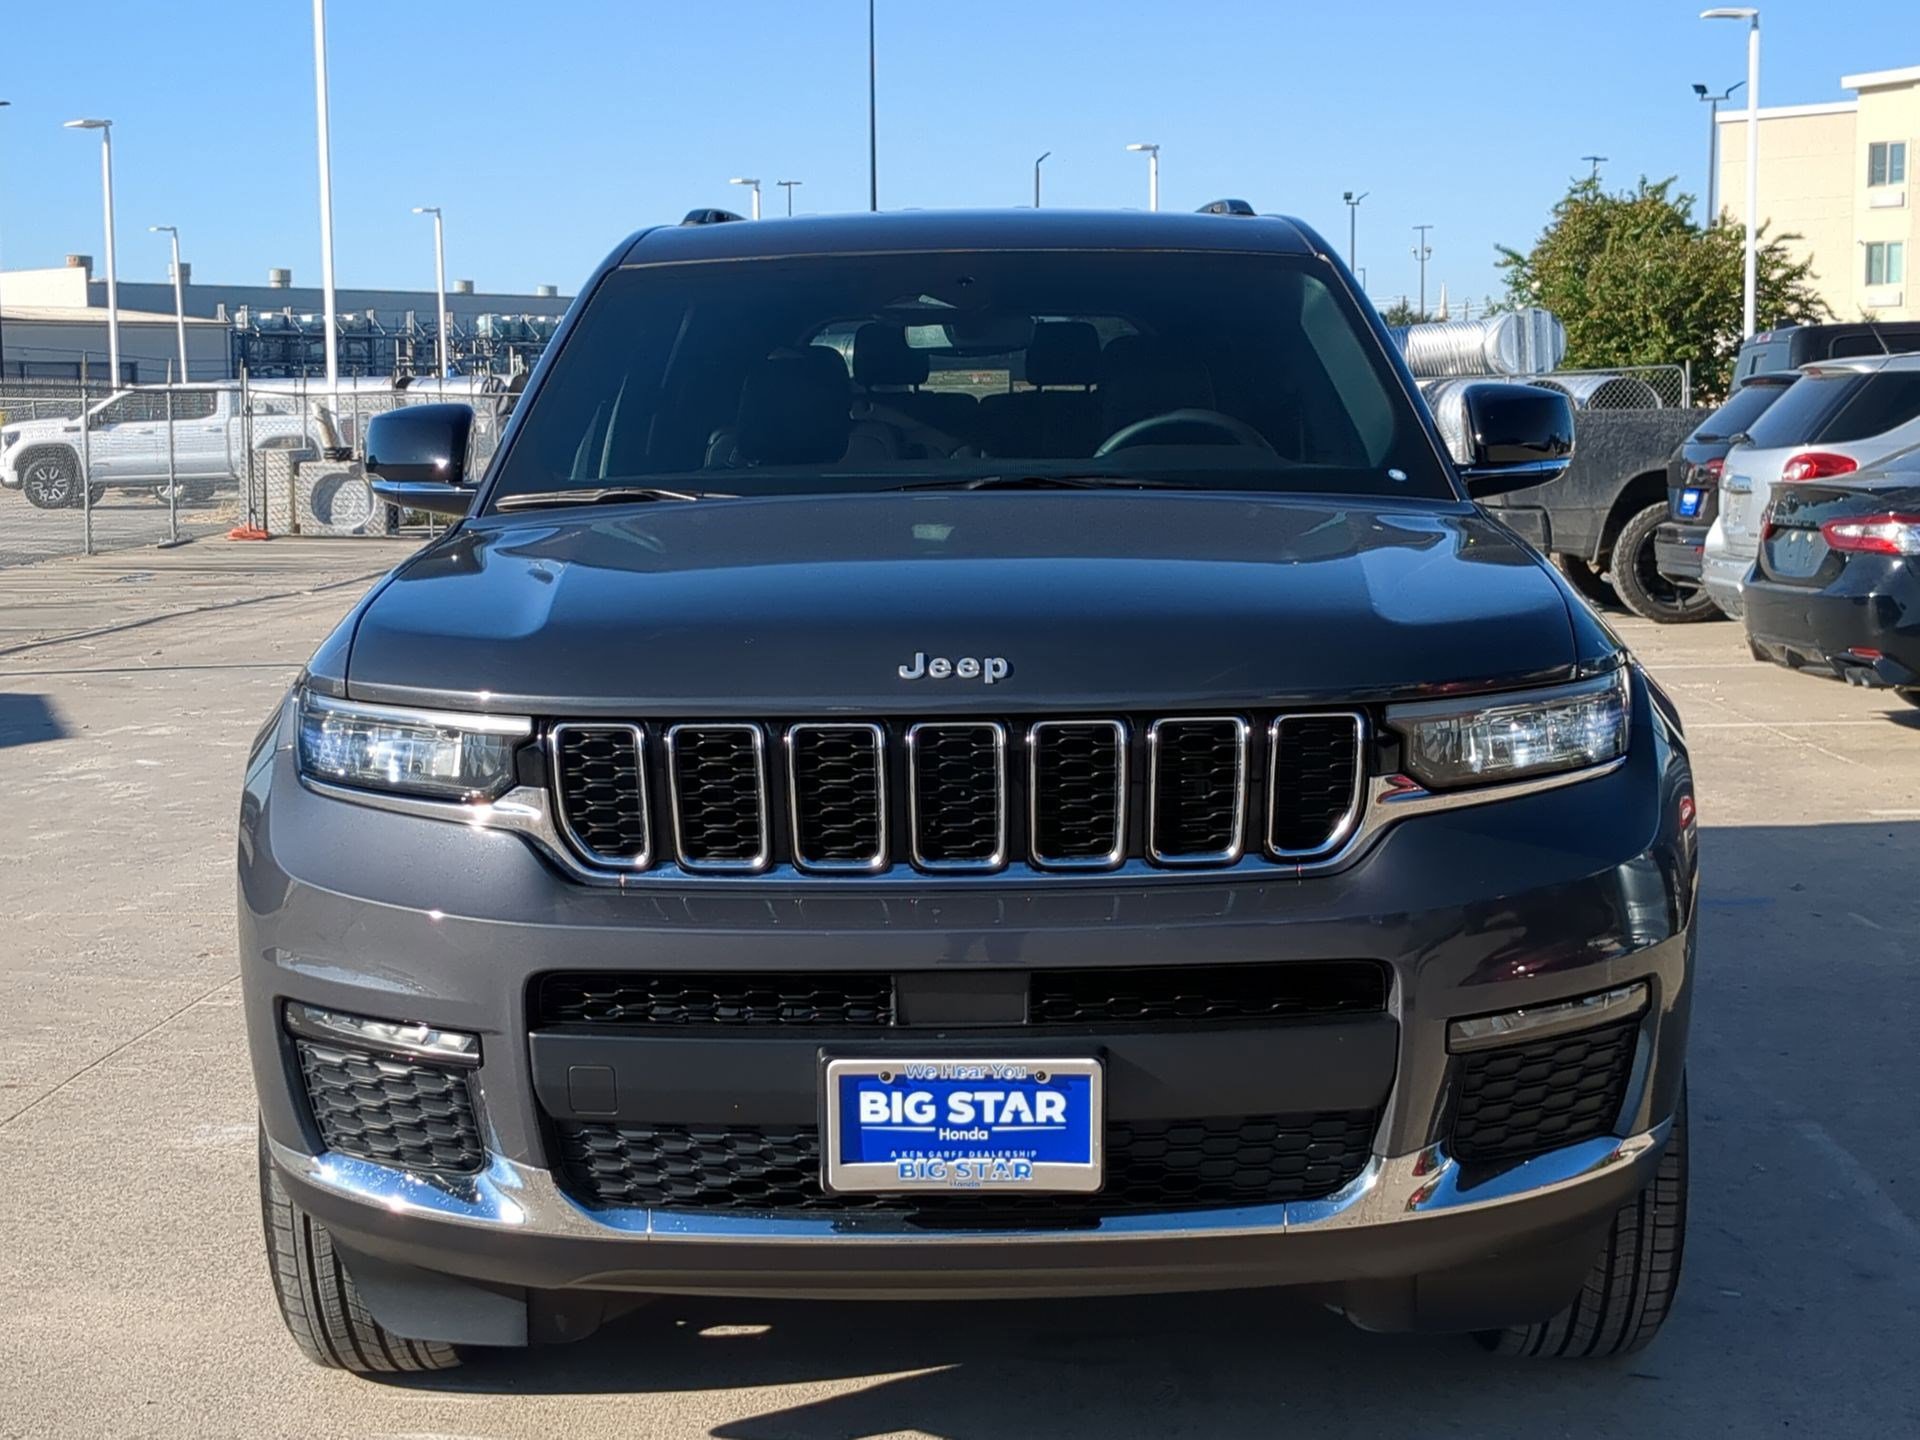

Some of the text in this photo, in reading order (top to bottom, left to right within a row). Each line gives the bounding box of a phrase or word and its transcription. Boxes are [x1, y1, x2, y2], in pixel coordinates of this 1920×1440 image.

[899, 652, 1008, 684] Jeep
[905, 1064, 1027, 1079] We Hear You
[860, 1091, 1066, 1123] BIG STAR
[939, 1128, 989, 1141] Honda
[890, 1150, 1037, 1158] A KEN GARFF DEALERSHIP
[897, 1159, 1032, 1180] BIG STAR
